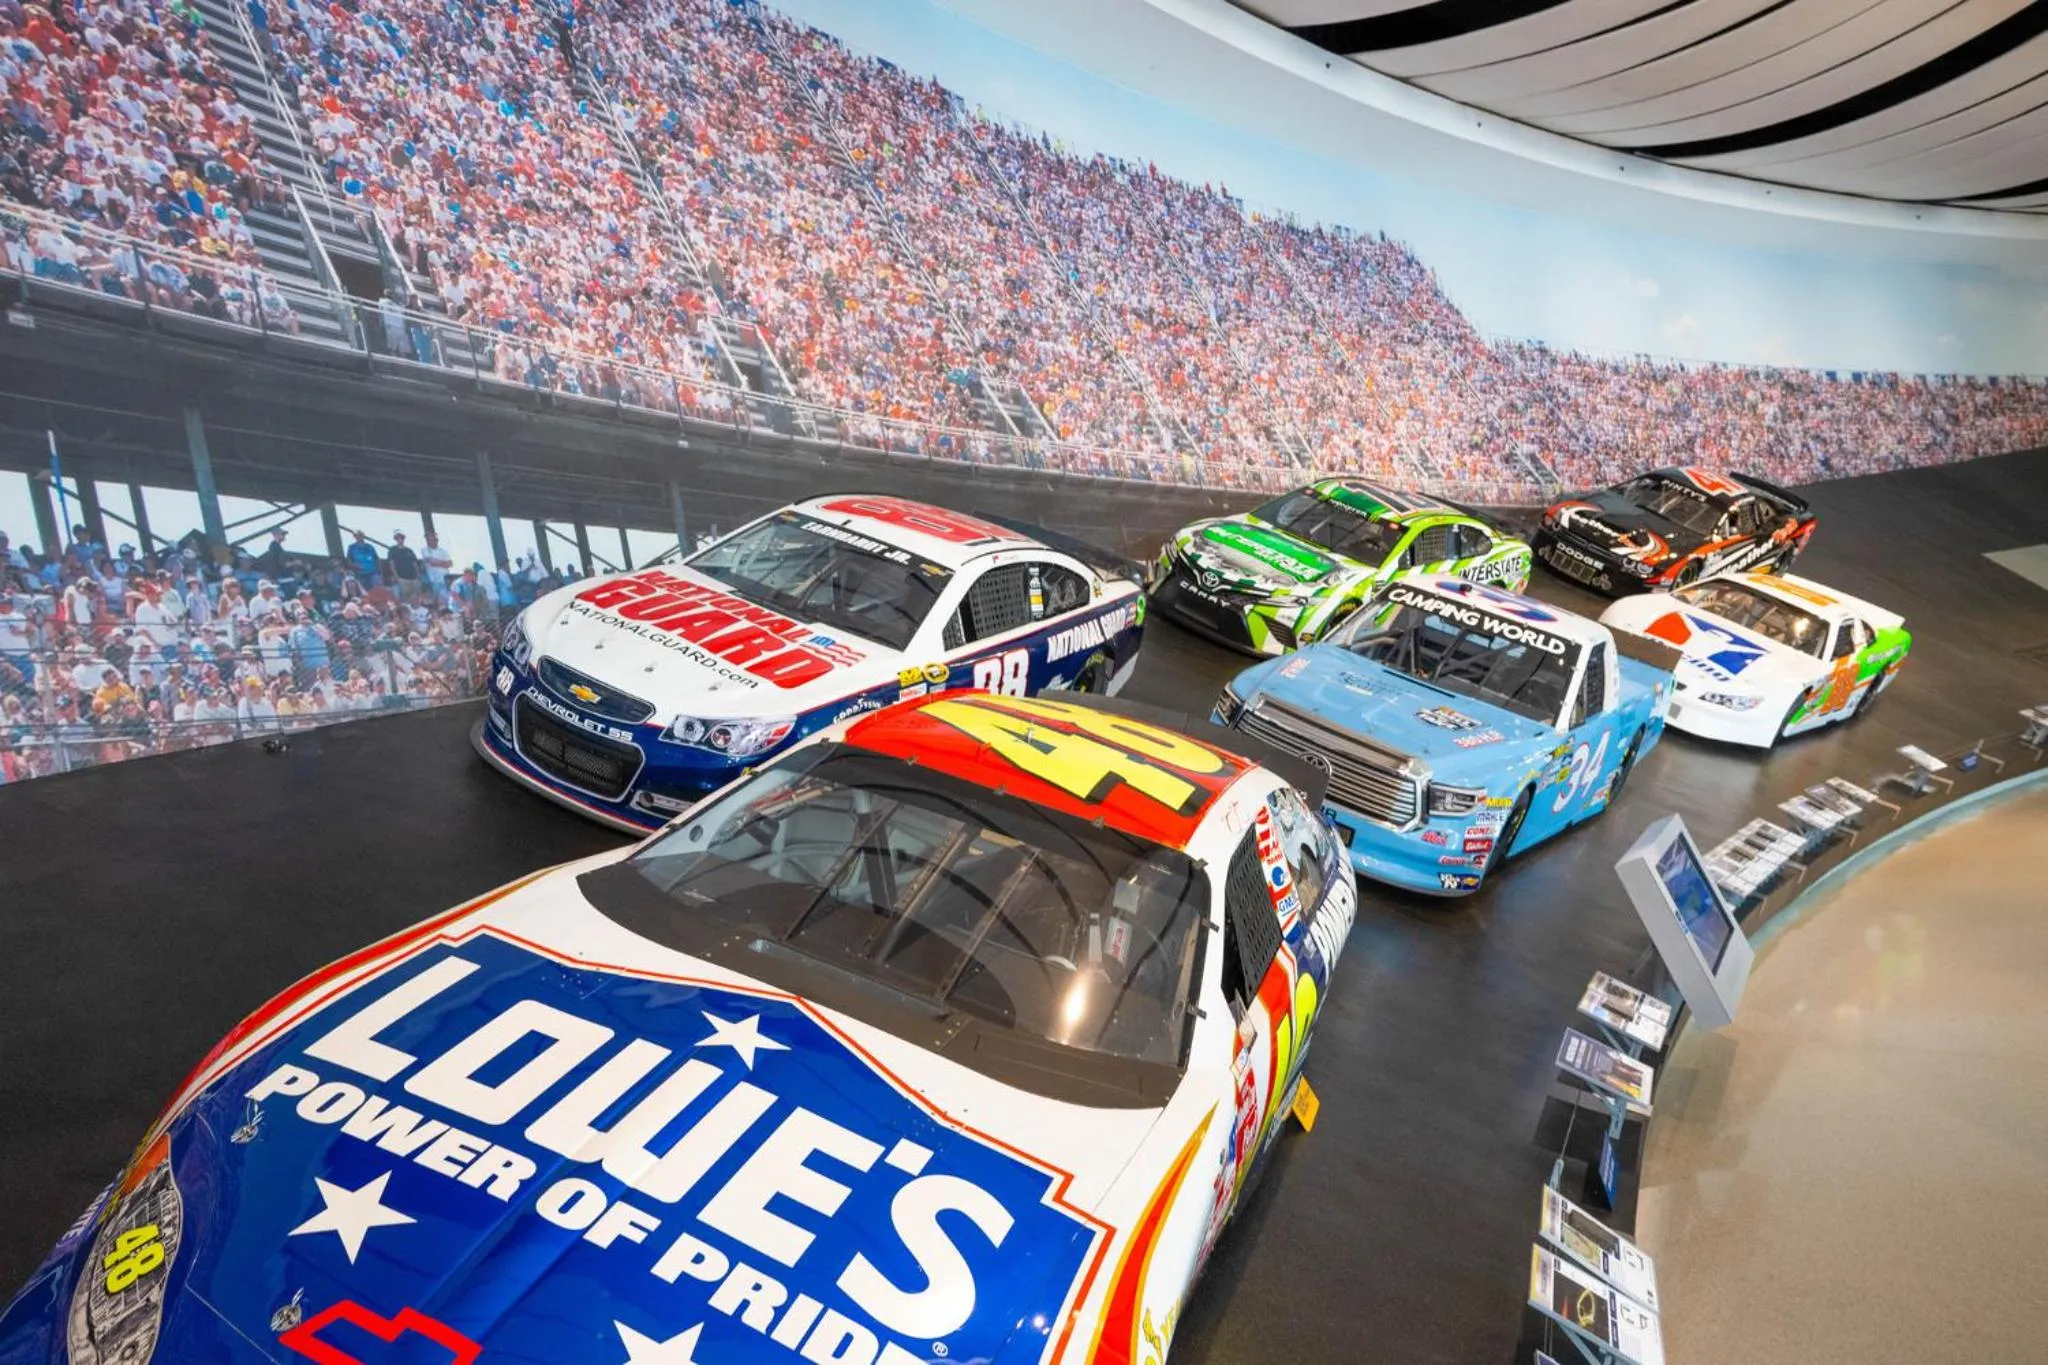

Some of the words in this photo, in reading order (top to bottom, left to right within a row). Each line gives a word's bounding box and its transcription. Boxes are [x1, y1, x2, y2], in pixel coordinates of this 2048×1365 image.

[1459, 556, 1522, 581] INTERSTATE
[1556, 541, 1605, 570] DODGE
[575, 579, 835, 690] GUARD
[633, 570, 814, 645] NATIONAL
[1046, 617, 1105, 665] NATIONAL
[1387, 588, 1481, 628] CAMPING
[1482, 617, 1567, 656] WORLD
[566, 601, 760, 690] NATIONALGUARD.com
[527, 686, 606, 733] CHEVROLET
[608, 727, 634, 742] SS
[917, 692, 1226, 812] 48
[1552, 729, 1612, 814] 34
[244, 1063, 537, 1202] POWER
[535, 1177, 662, 1249] OF
[303, 955, 1016, 1339] LOWE'S
[102, 1221, 166, 1295] 48
